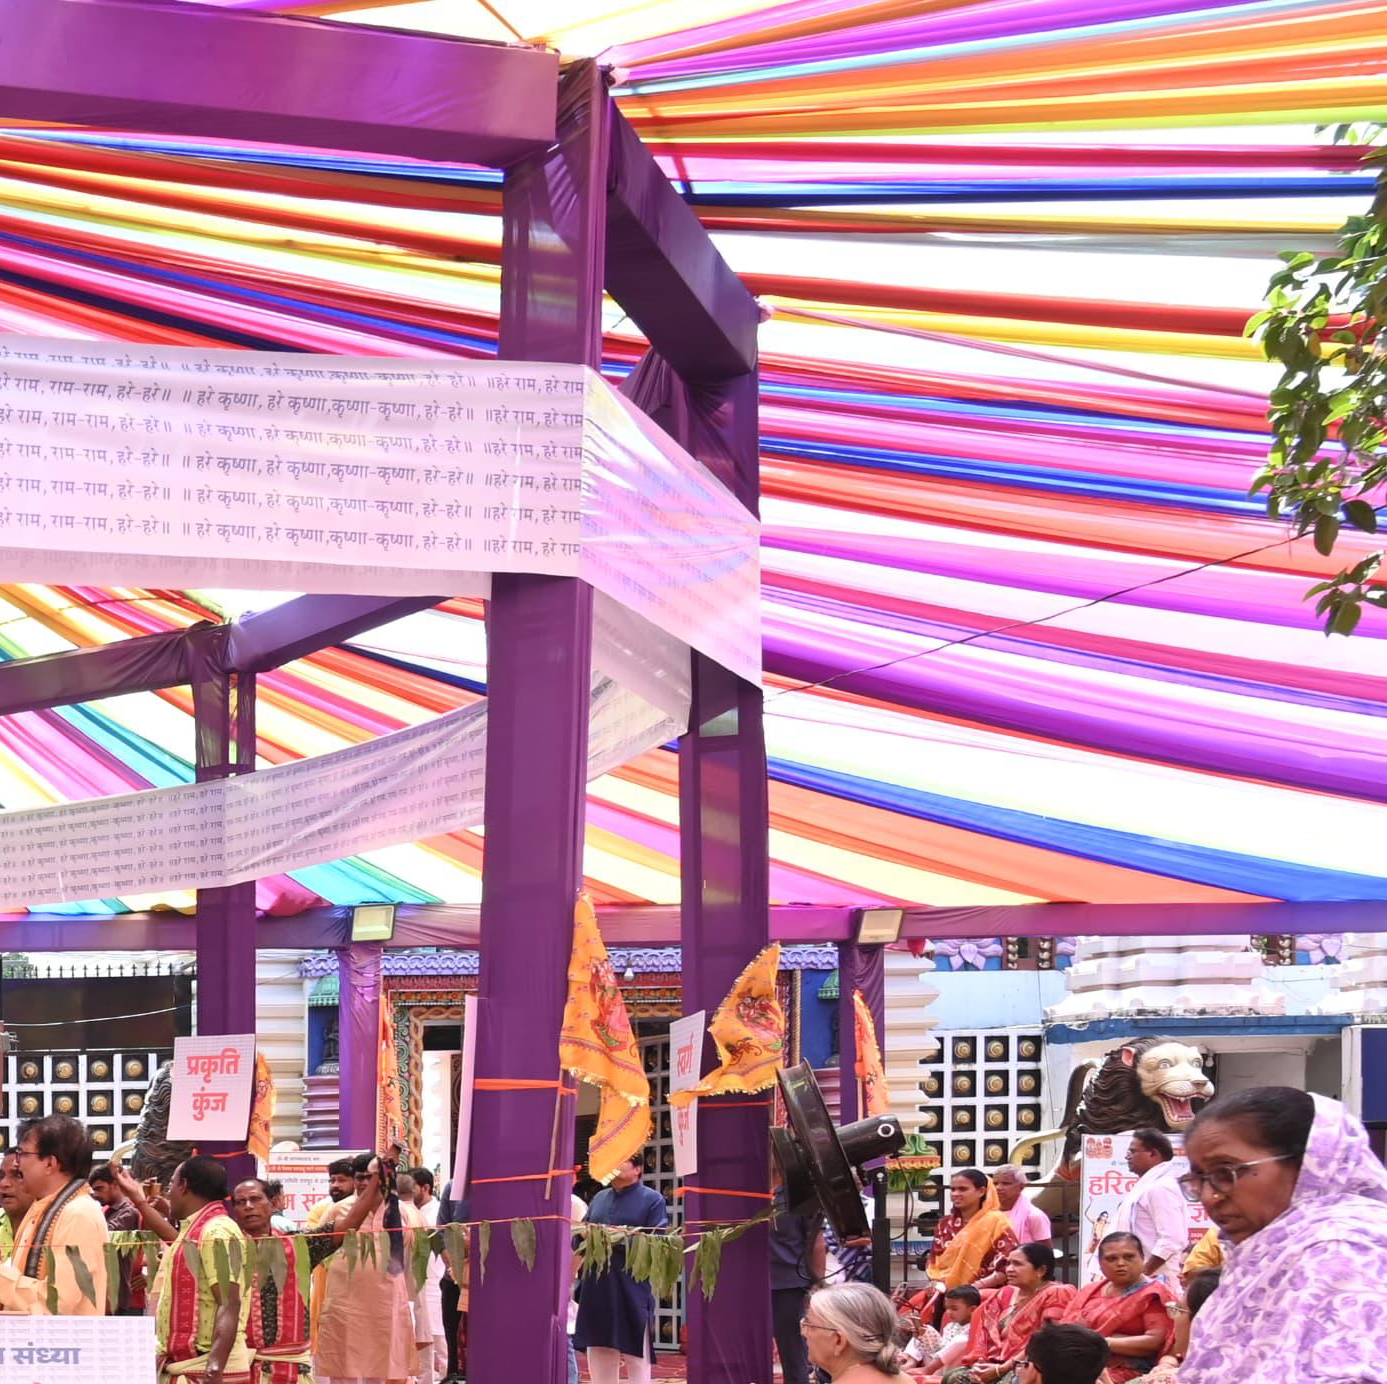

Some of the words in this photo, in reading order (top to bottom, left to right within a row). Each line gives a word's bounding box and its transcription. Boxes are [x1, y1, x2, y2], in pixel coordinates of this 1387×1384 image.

[186, 1046, 240, 1081] प्रकृति
[192, 1089, 228, 1120] कुंज
[12, 1340, 81, 1365] संध्या
